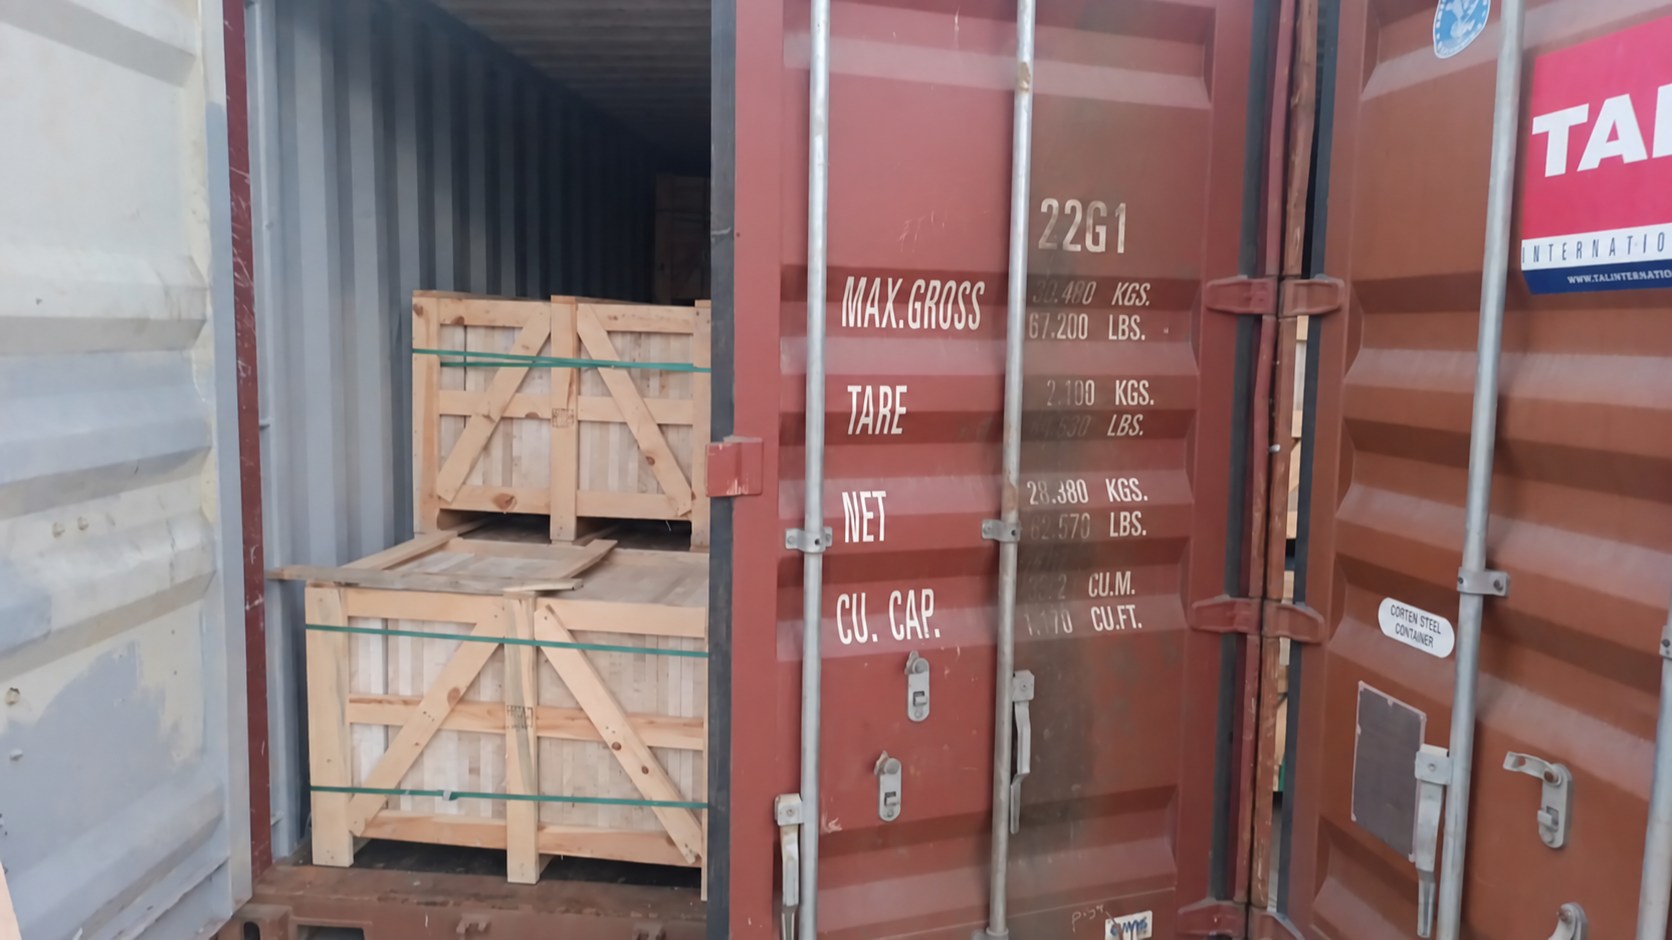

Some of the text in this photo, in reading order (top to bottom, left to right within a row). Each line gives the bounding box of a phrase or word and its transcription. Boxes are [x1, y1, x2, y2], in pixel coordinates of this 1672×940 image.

[1039, 198, 1126, 253] 22G1
[1522, 232, 1666, 263] INTERNATIO
[842, 276, 985, 330] MAX.GROSS
[1032, 279, 1150, 306] 30.480 KGS.
[1029, 312, 1145, 341] 67.200 LBS.
[1047, 379, 1154, 406] 2.100 KGS.
[848, 385, 907, 435] TARE
[1107, 414, 1143, 437] LBS.
[1027, 478, 1148, 505] 28.380 KGS.
[842, 491, 886, 543] NET
[1110, 511, 1147, 537] LBS.
[1088, 571, 1135, 597] CU.M.
[836, 588, 941, 644] CU. CAP.
[1091, 604, 1142, 631] CU.FT.
[1390, 604, 1441, 634] CORTEN STEEL
[1395, 622, 1434, 648] CONTAINER
